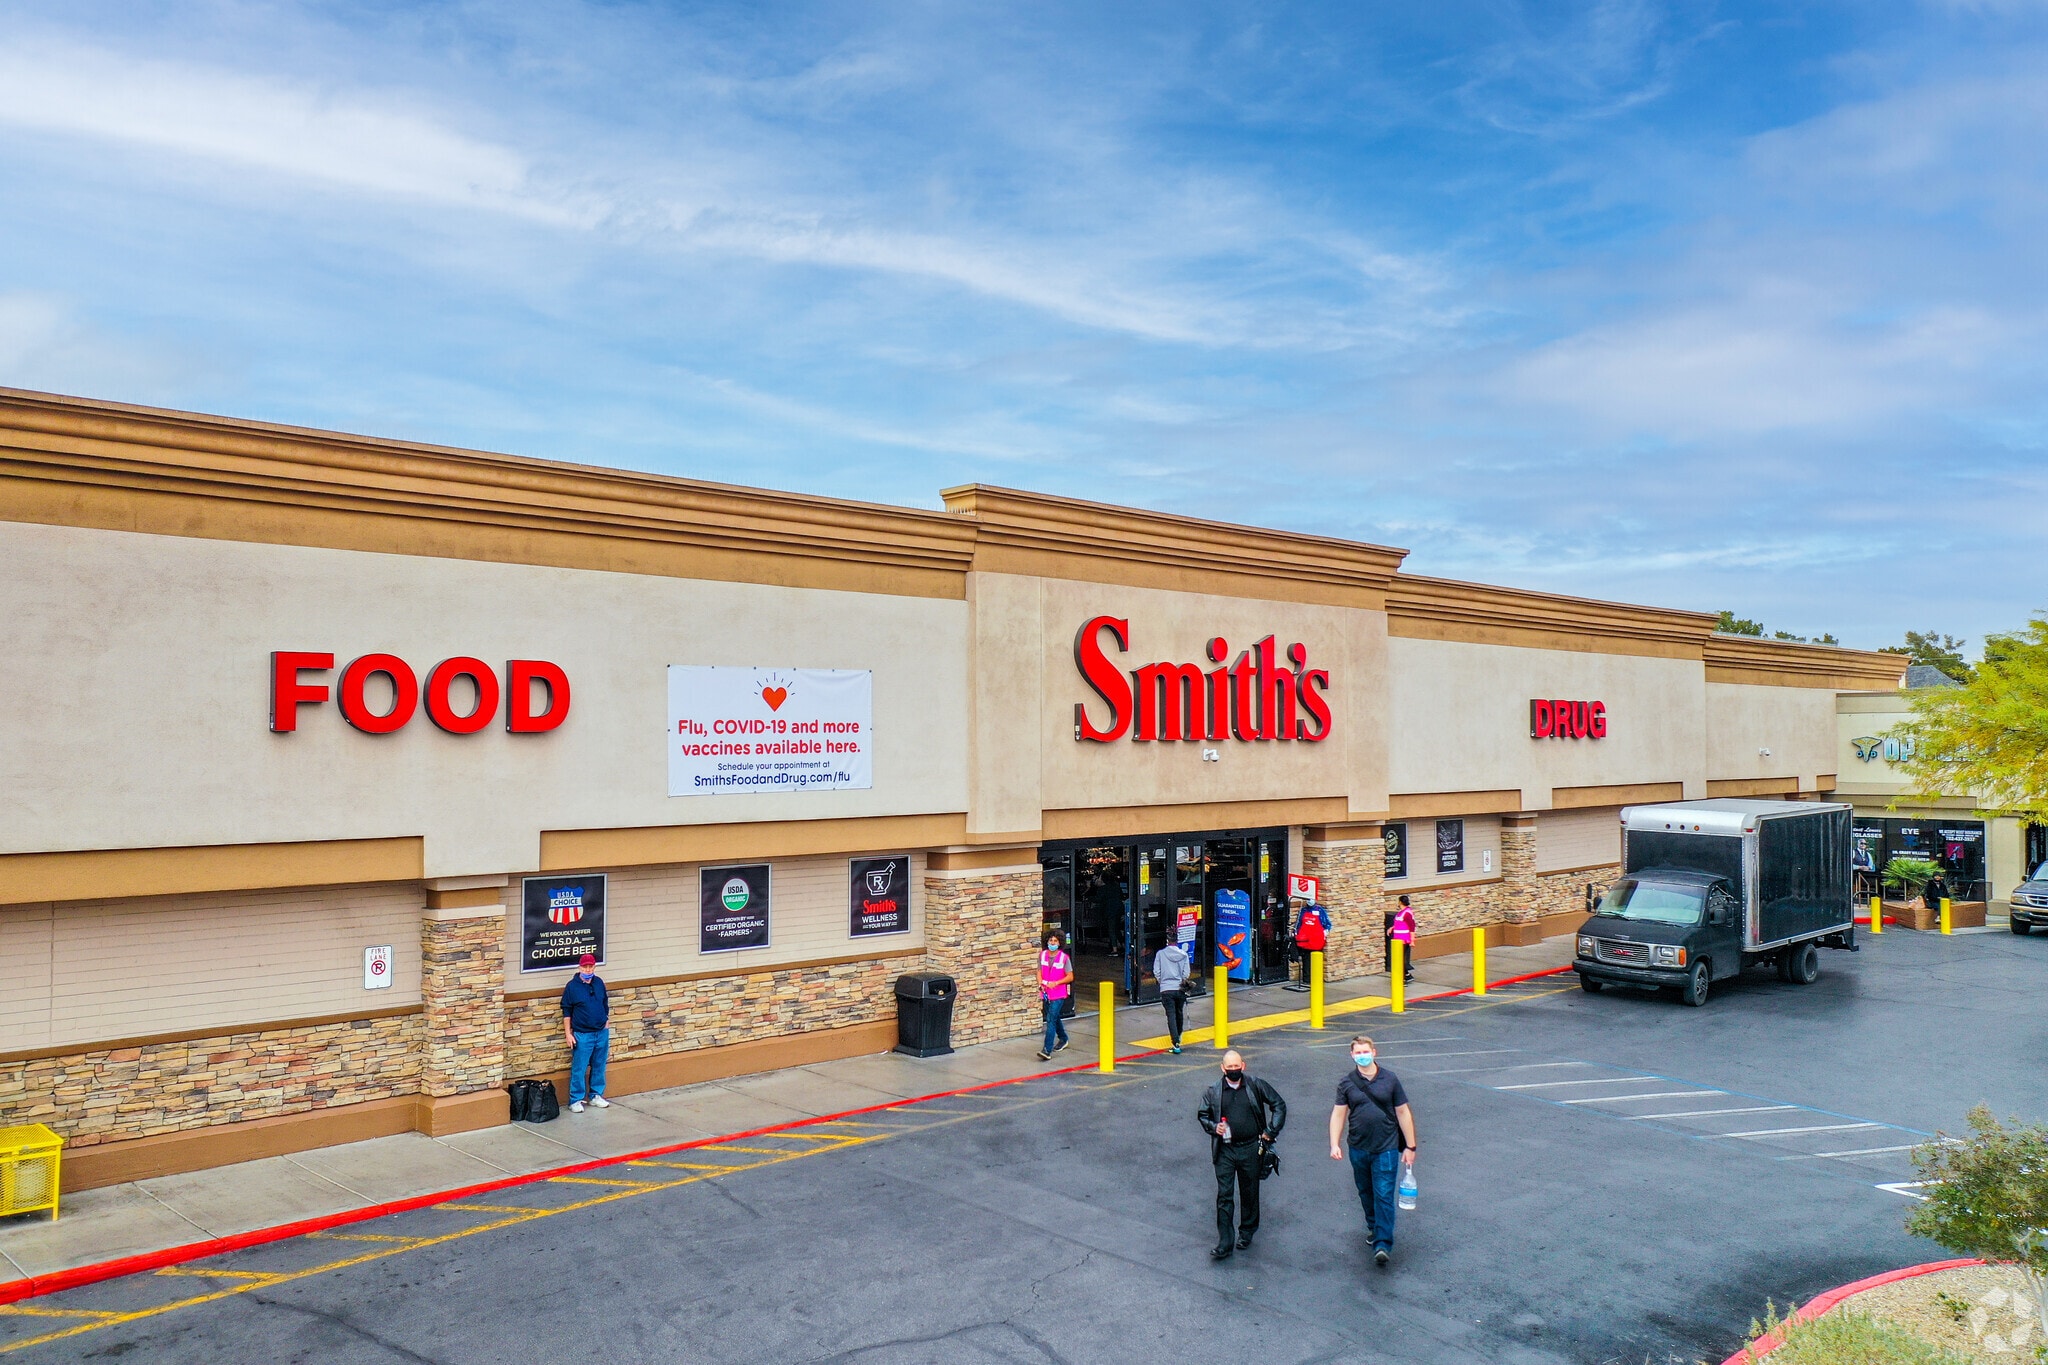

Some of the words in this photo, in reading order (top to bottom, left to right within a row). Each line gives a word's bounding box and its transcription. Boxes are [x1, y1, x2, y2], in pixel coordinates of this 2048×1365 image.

[1074, 615, 1332, 742] Smith's
[270, 651, 571, 734] FOOD
[1530, 698, 1606, 739] DRUG
[678, 719, 708, 737] Flu,
[713, 719, 787, 735] COVID-19
[791, 719, 818, 734] and
[823, 721, 860, 734] more
[682, 740, 750, 756] vaccines
[755, 739, 822, 755] available
[826, 739, 861, 753] here.
[717, 762, 754, 771] Schedule
[755, 763, 772, 771] your
[774, 761, 821, 770] appointment
[694, 771, 850, 787] SmithsFoodandDrug.com/flu
[728, 886, 744, 894] USDA
[863, 899, 897, 914] Smith's
[705, 923, 736, 931] CERTIFIED
[737, 920, 765, 928] ORGANIC
[862, 913, 898, 924] WELLNESS
[720, 929, 750, 937] FARMERS
[550, 937, 582, 946] U.S.D.A.
[370, 953, 386, 961] LANE
[532, 948, 570, 959] CHOICE
[572, 945, 597, 955] BEEF
